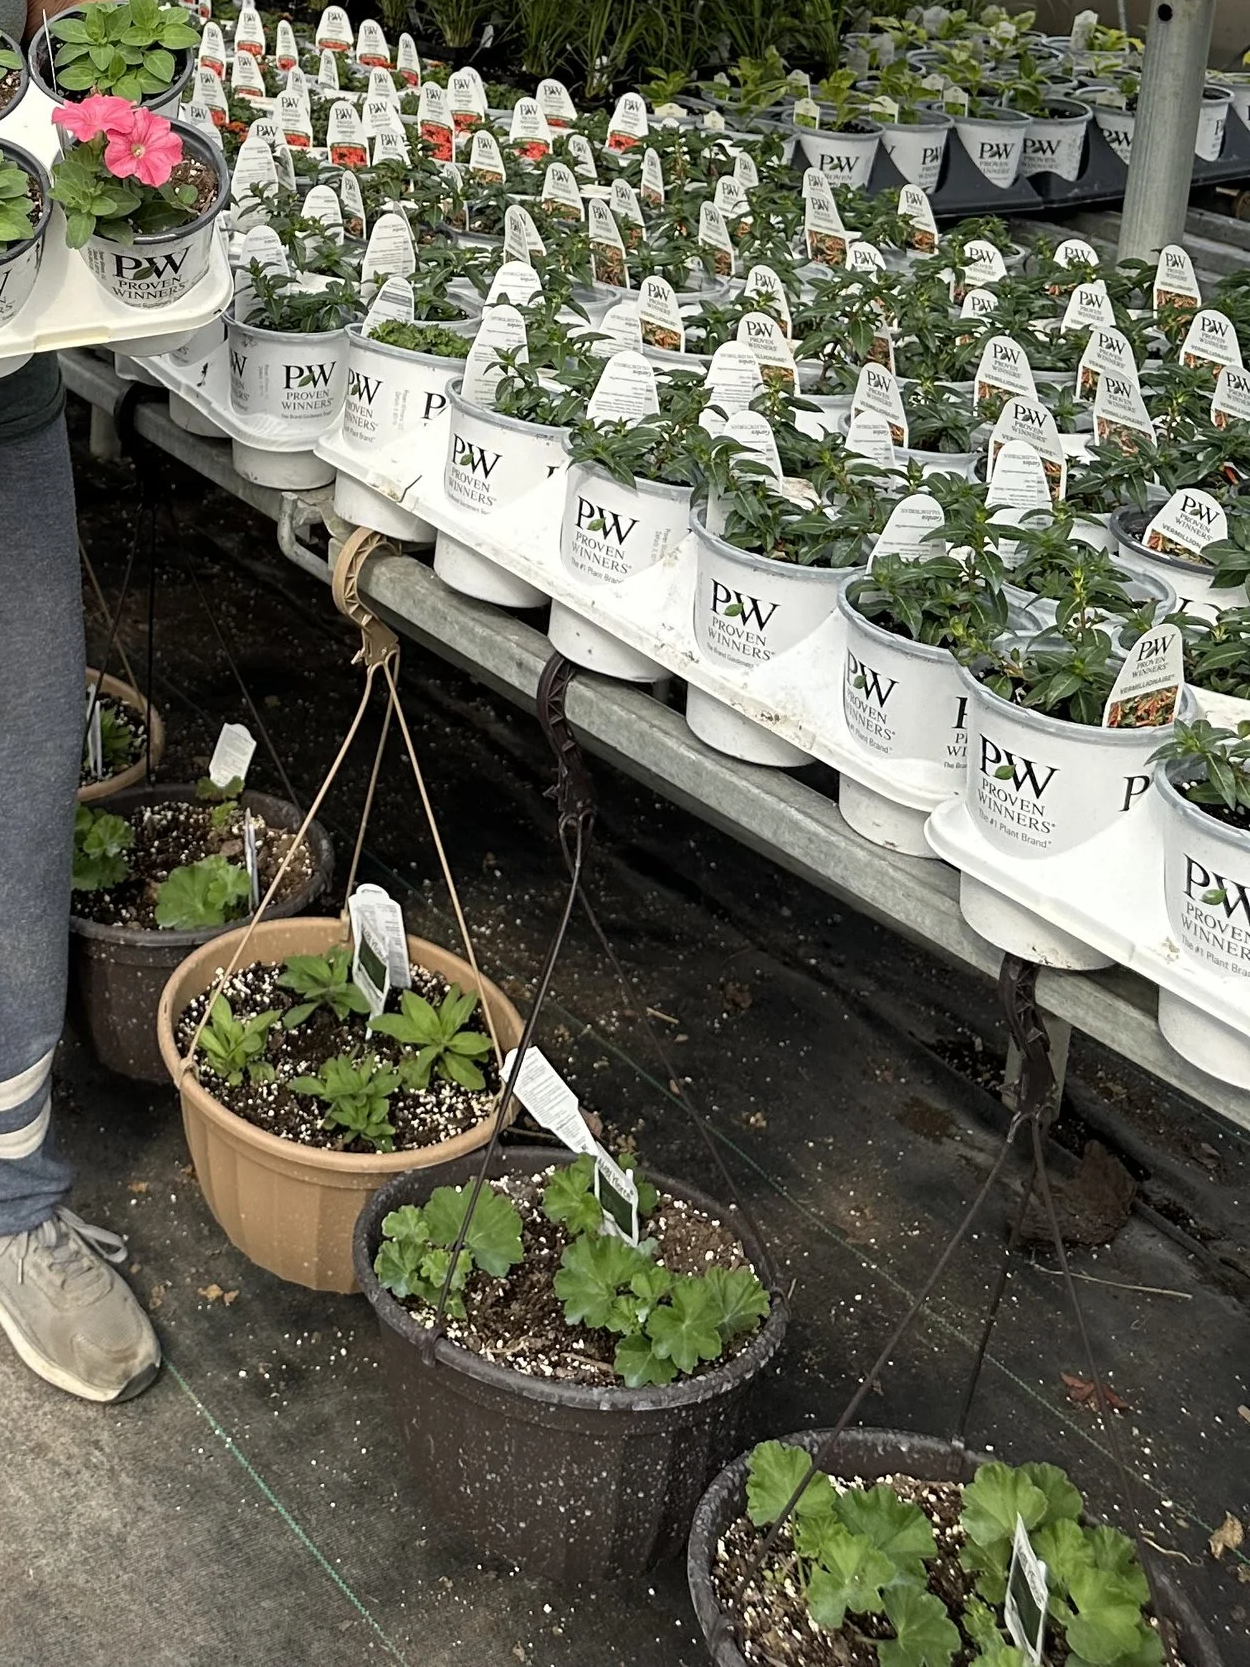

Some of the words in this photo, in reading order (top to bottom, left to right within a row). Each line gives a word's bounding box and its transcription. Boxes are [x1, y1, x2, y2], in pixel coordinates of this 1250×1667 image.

[979, 142, 1015, 160] PW
[1022, 138, 1062, 156] PW
[819, 154, 860, 173] PW
[111, 244, 193, 281] PW
[1166, 252, 1186, 269] PW
[112, 283, 186, 299] WINNERS
[118, 274, 182, 291] PROVEN
[647, 283, 670, 301] PW
[1079, 290, 1105, 309] PW
[746, 320, 774, 338] PW
[1201, 317, 1229, 337] PW
[993, 343, 1021, 365] PW
[282, 361, 337, 389] PW
[866, 369, 892, 392] PW
[286, 389, 330, 401] PROVEN
[1106, 377, 1132, 398] PW
[1014, 403, 1048, 428] PW
[1014, 420, 1044, 435] PROVEN
[452, 433, 503, 479] PW
[451, 466, 490, 493] PROVEN
[575, 495, 640, 545] PW
[1180, 494, 1220, 525] PW
[1180, 513, 1211, 533] PROVEN
[576, 531, 625, 560] PROVEN
[1162, 523, 1201, 548] VERMILLION
[571, 541, 629, 574] WINNERS
[710, 578, 781, 632] PW
[712, 616, 767, 647] PROVEN
[707, 626, 771, 662] WINNERS
[1137, 634, 1176, 663] PW
[1135, 653, 1166, 670] PROVEN
[847, 646, 899, 708] PW
[979, 733, 1060, 800] PW
[981, 777, 1046, 817] PROVEN
[977, 789, 1051, 834] WINNERS
[999, 821, 1019, 840] Plant
[1206, 950, 1229, 971] Plant
